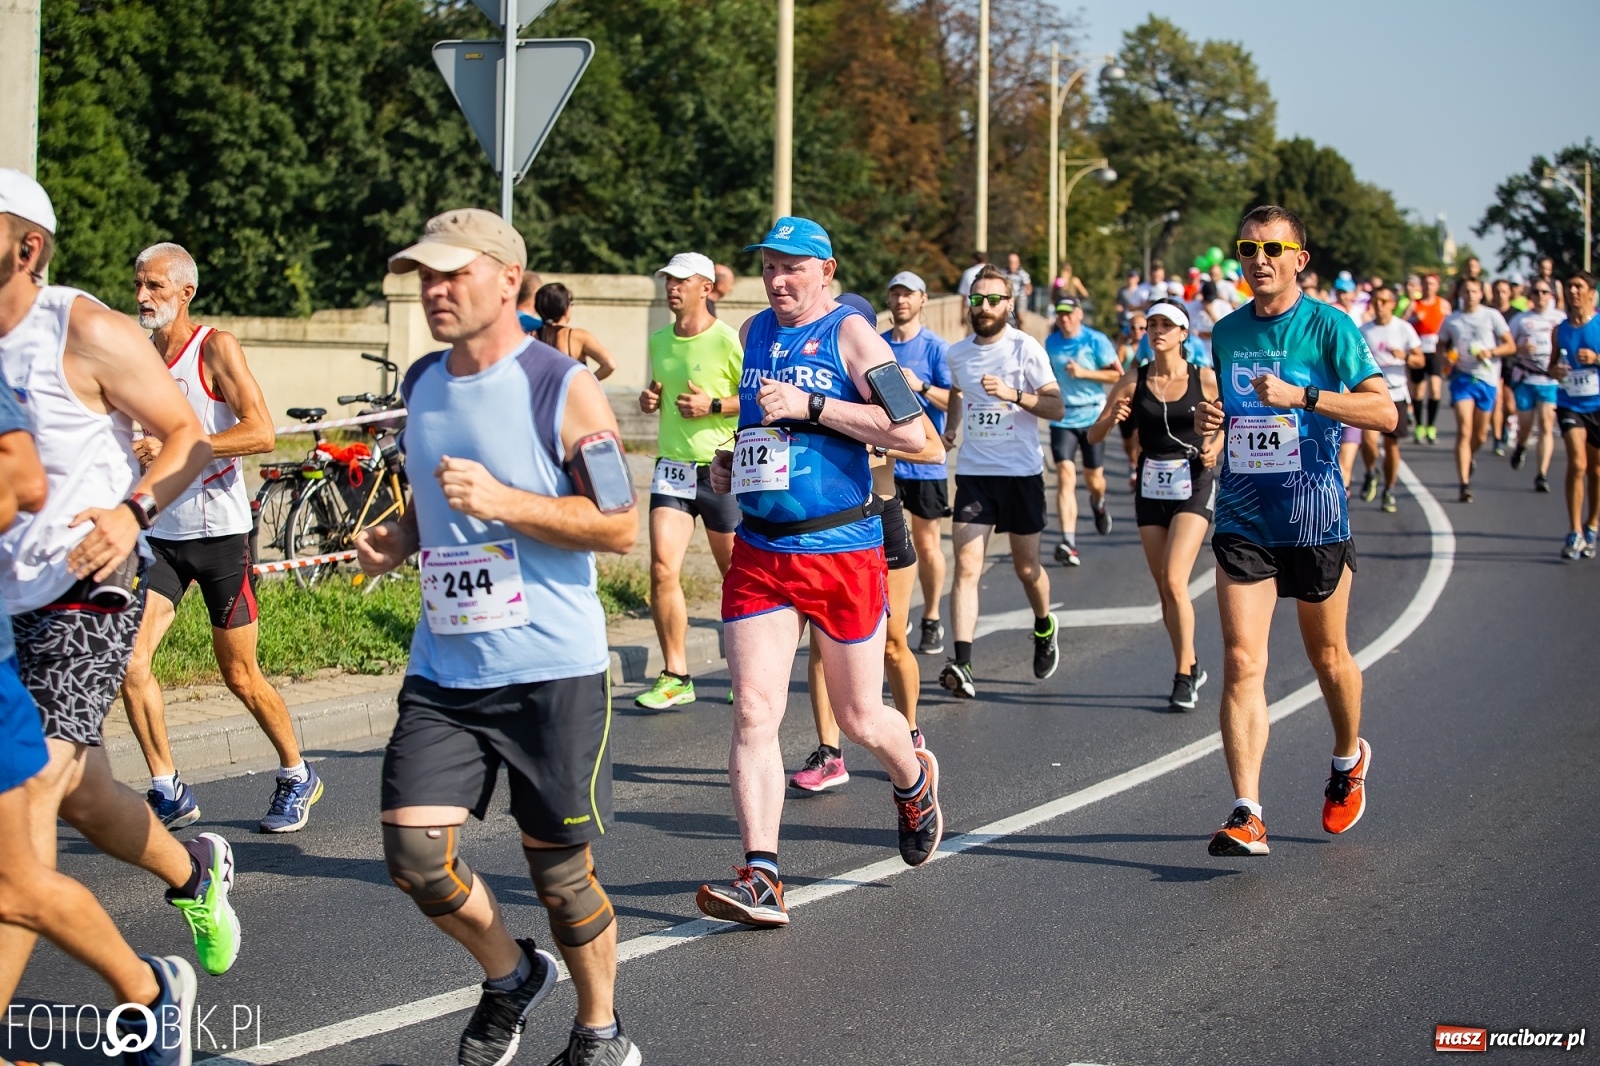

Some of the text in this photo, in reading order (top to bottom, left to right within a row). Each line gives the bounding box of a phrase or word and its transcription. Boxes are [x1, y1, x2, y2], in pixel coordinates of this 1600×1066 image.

[738, 365, 833, 390] UNNERS
[978, 412, 1001, 425] 327
[1247, 431, 1281, 450] 124
[740, 444, 768, 467] 212
[664, 466, 686, 481] 156
[1157, 472, 1173, 484] 57
[443, 568, 493, 598] 244
